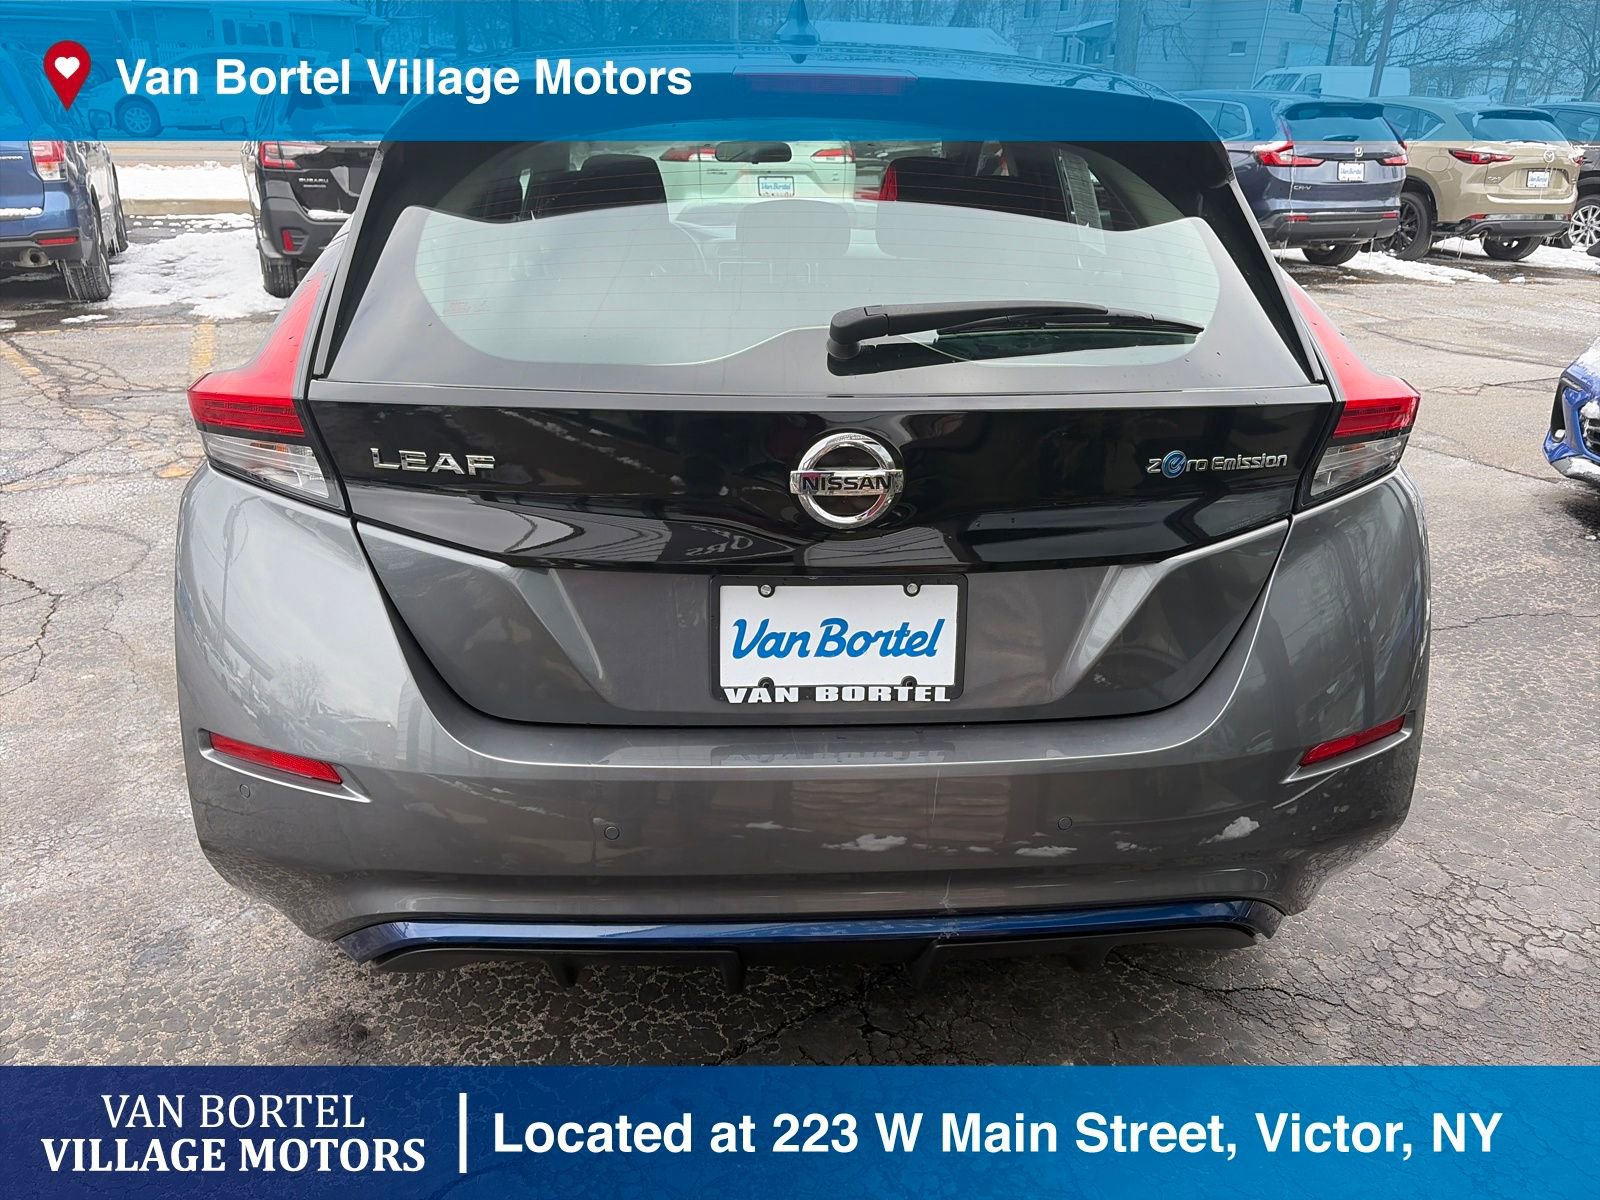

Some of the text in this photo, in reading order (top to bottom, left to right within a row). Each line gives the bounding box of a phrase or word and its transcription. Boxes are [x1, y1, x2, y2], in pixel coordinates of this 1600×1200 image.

[369, 447, 496, 476] LEAF
[1211, 452, 1288, 471] Emission
[802, 475, 892, 491] NISSAN
[732, 617, 945, 659] Van Bortel
[723, 685, 951, 704] VAN BORTEL
